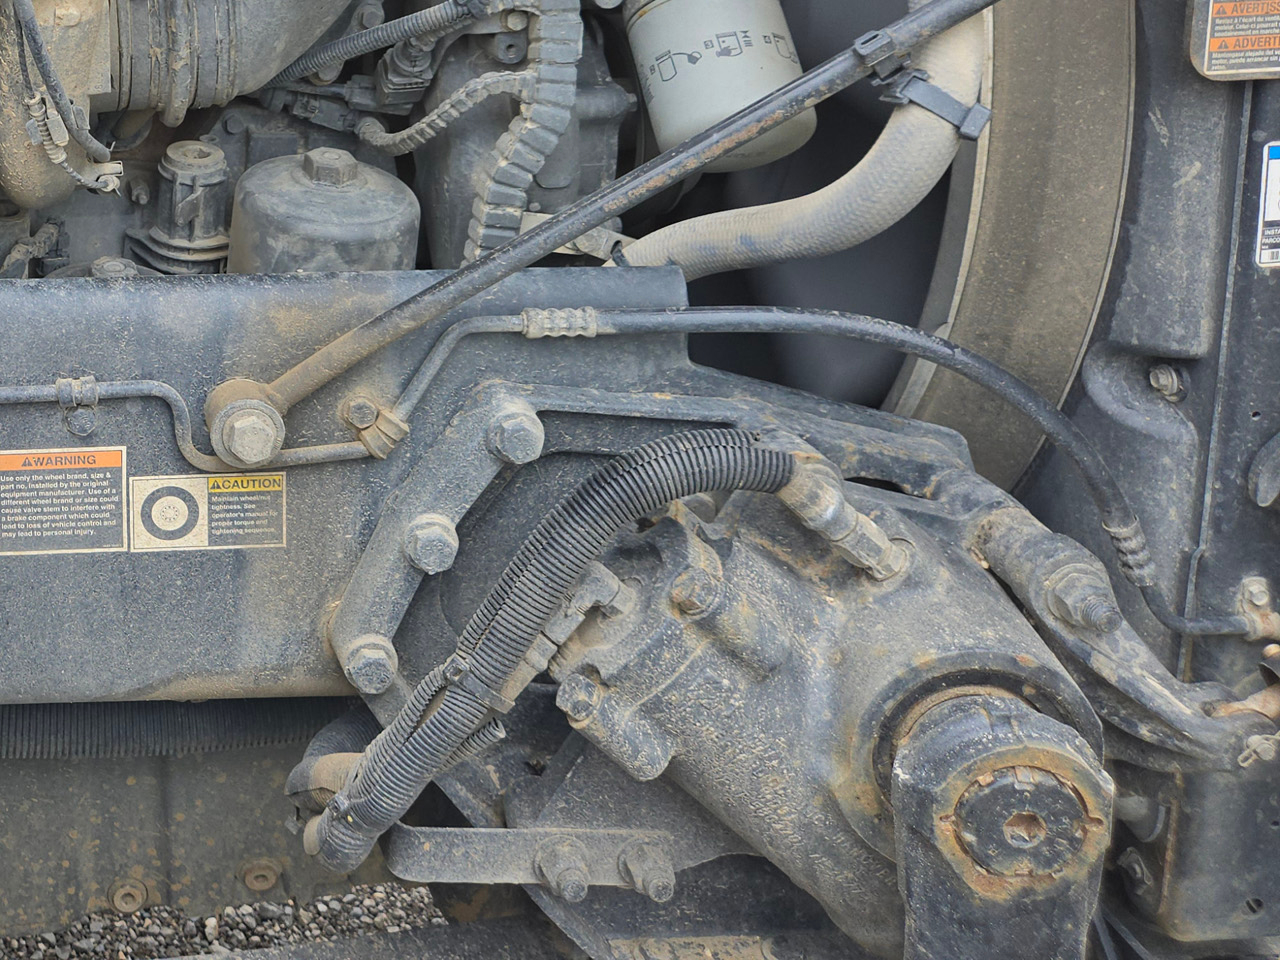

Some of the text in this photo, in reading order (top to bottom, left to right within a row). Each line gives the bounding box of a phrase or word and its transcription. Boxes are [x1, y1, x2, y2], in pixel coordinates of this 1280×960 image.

[33, 455, 96, 466] WARNING
[221, 478, 281, 490] CAUTION
[43, 529, 73, 537] personal
[74, 528, 96, 536] injury.
